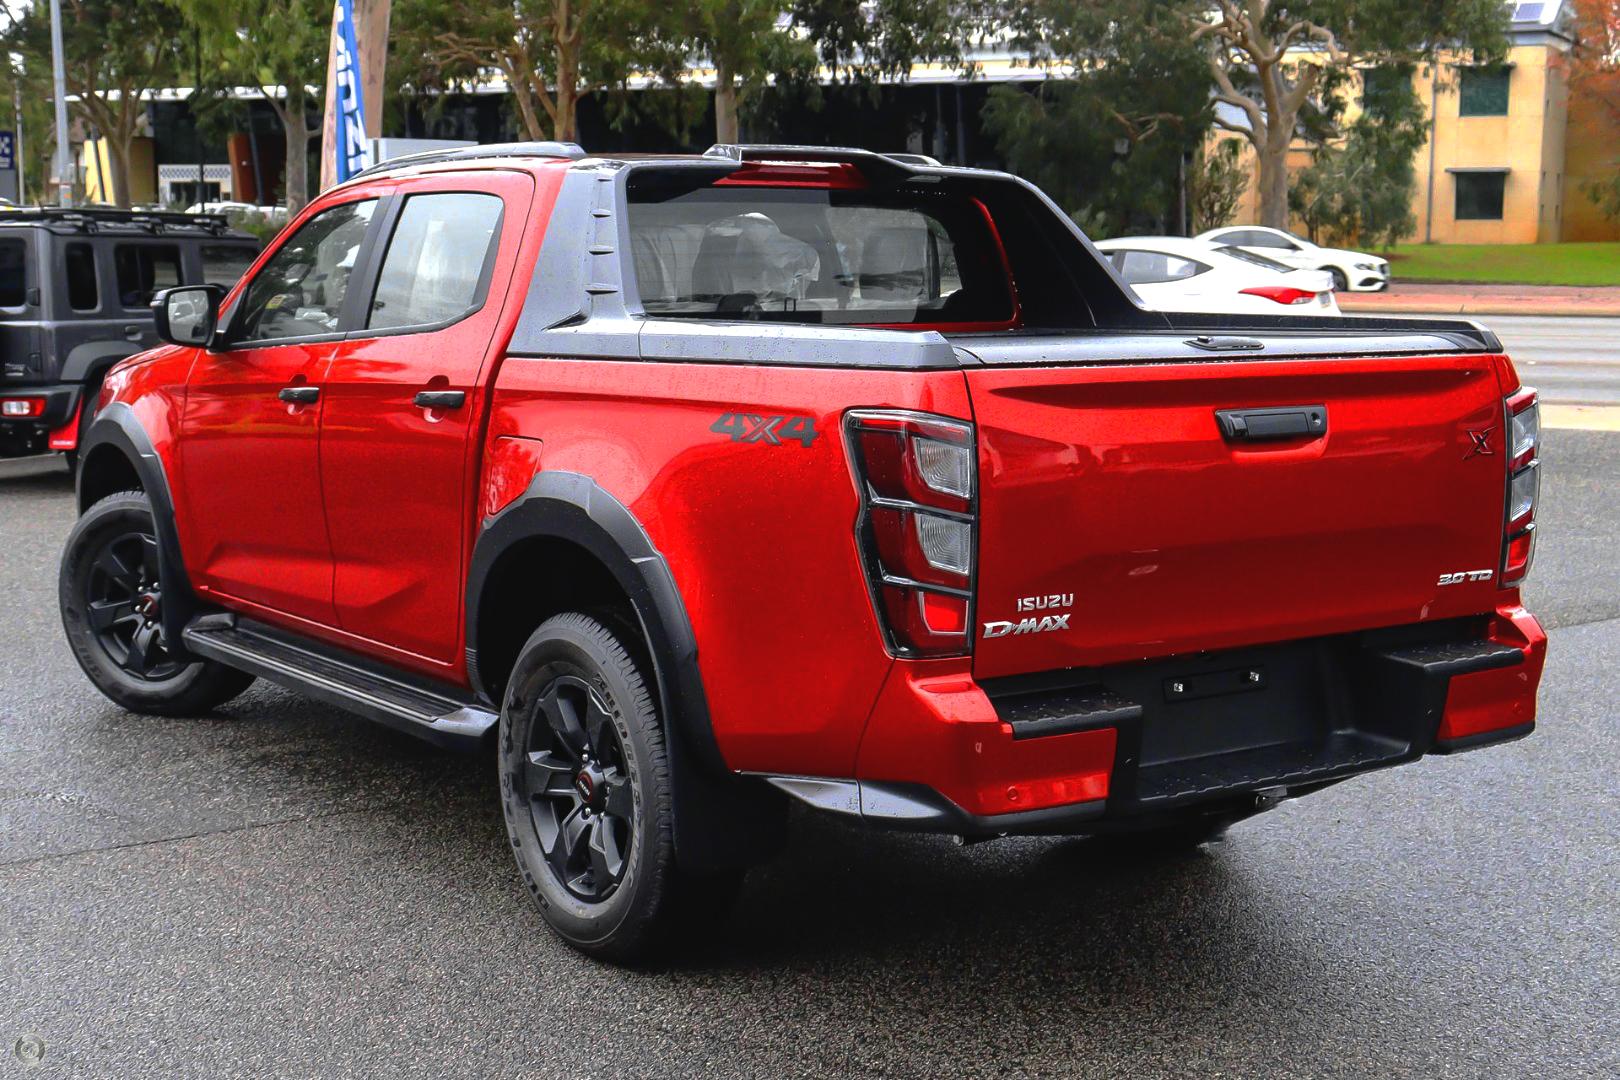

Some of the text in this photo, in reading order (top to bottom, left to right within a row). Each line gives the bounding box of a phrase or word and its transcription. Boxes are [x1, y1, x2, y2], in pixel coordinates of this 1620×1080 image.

[709, 412, 819, 447] 4X4
[1017, 593, 1074, 612] ISUZU
[983, 613, 1071, 639] D-MAX
